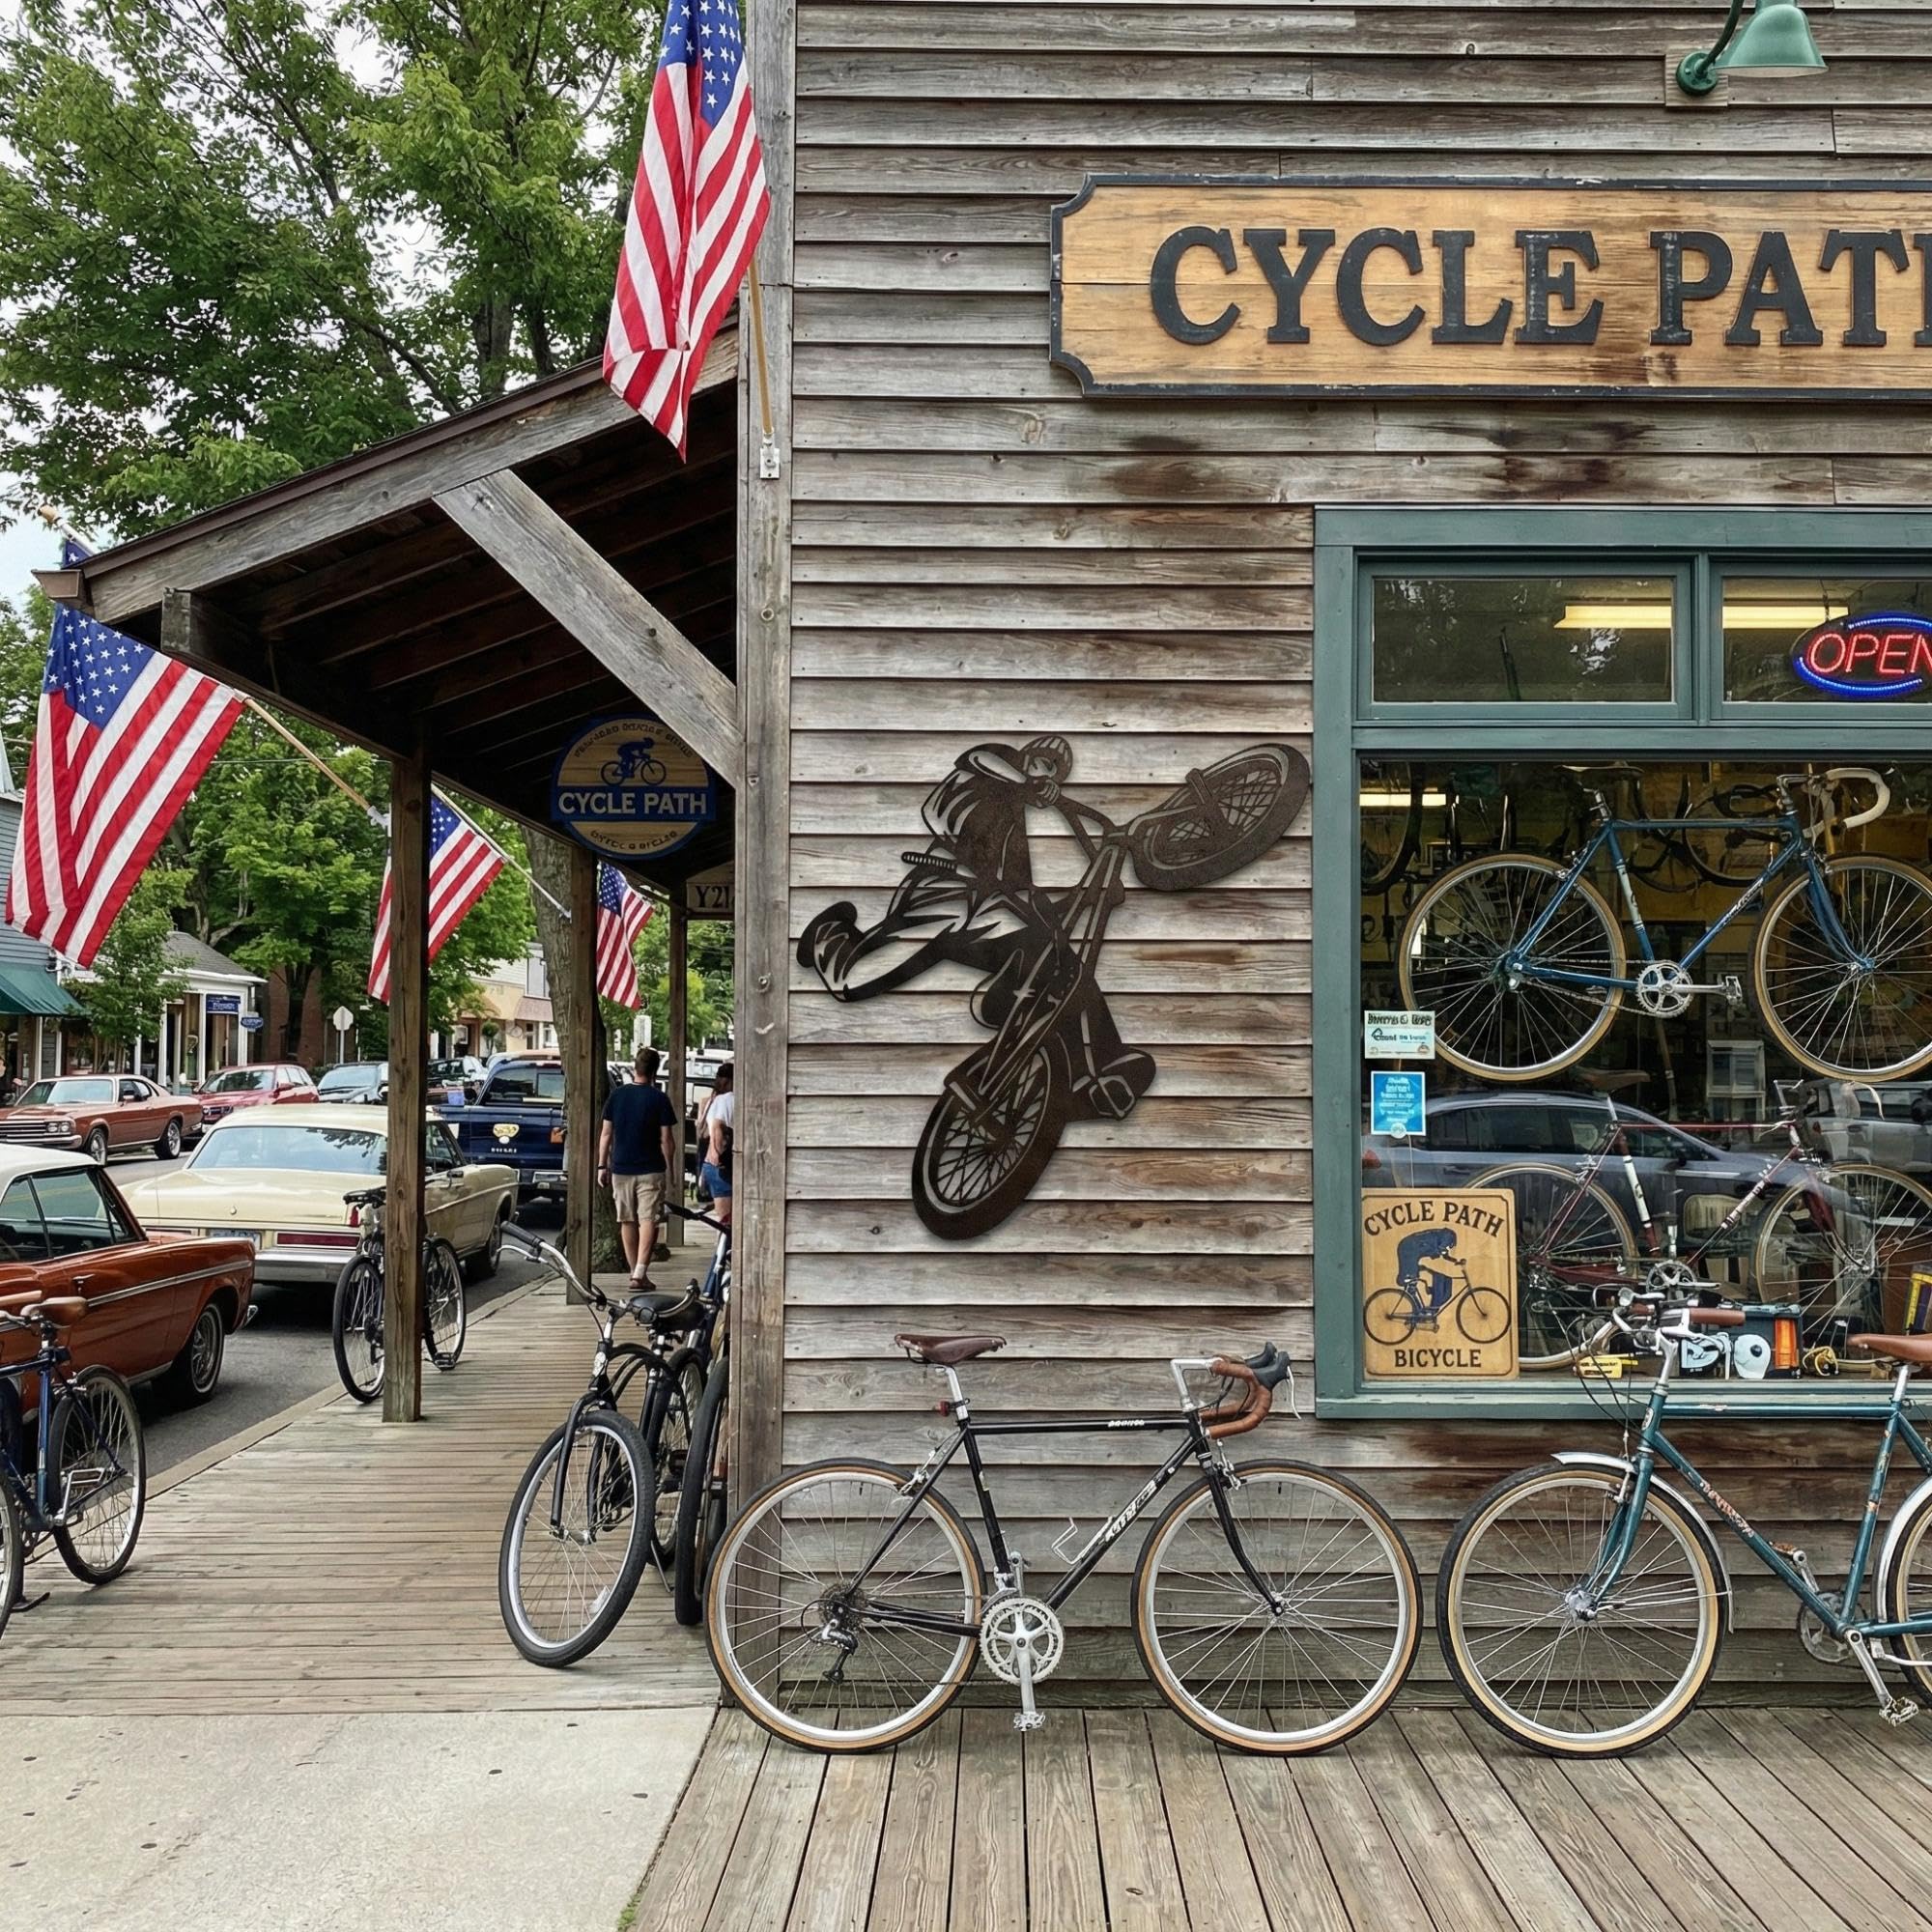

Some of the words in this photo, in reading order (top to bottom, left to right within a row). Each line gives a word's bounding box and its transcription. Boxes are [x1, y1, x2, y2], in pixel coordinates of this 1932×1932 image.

[1150, 225, 1605, 346] CYCLE
[1648, 229, 1932, 348] PAT
[557, 792, 637, 814] CYCLE
[643, 792, 707, 814] PATH
[1363, 1200, 1435, 1236] CYCLE
[1442, 1201, 1505, 1237] PATH
[1394, 1349, 1482, 1368] BICYCLE
